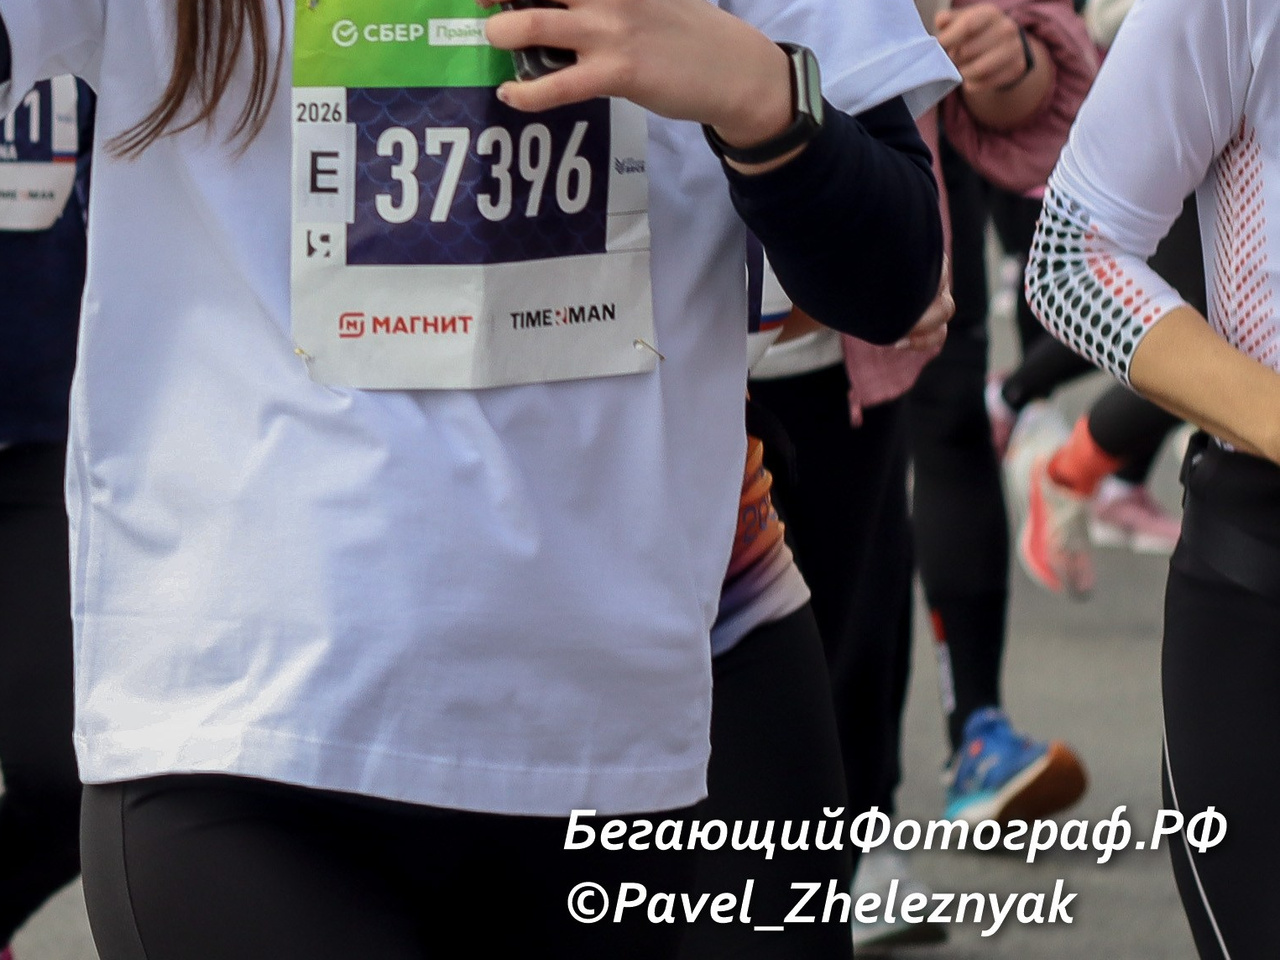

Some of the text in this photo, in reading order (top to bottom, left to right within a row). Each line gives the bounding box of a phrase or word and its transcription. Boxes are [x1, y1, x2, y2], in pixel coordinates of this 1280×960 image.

[363, 23, 424, 42] СБЕР
[296, 103, 342, 123] 2026
[309, 150, 339, 194] E
[374, 120, 592, 224] 37396
[372, 315, 474, 335] МАГНИТ
